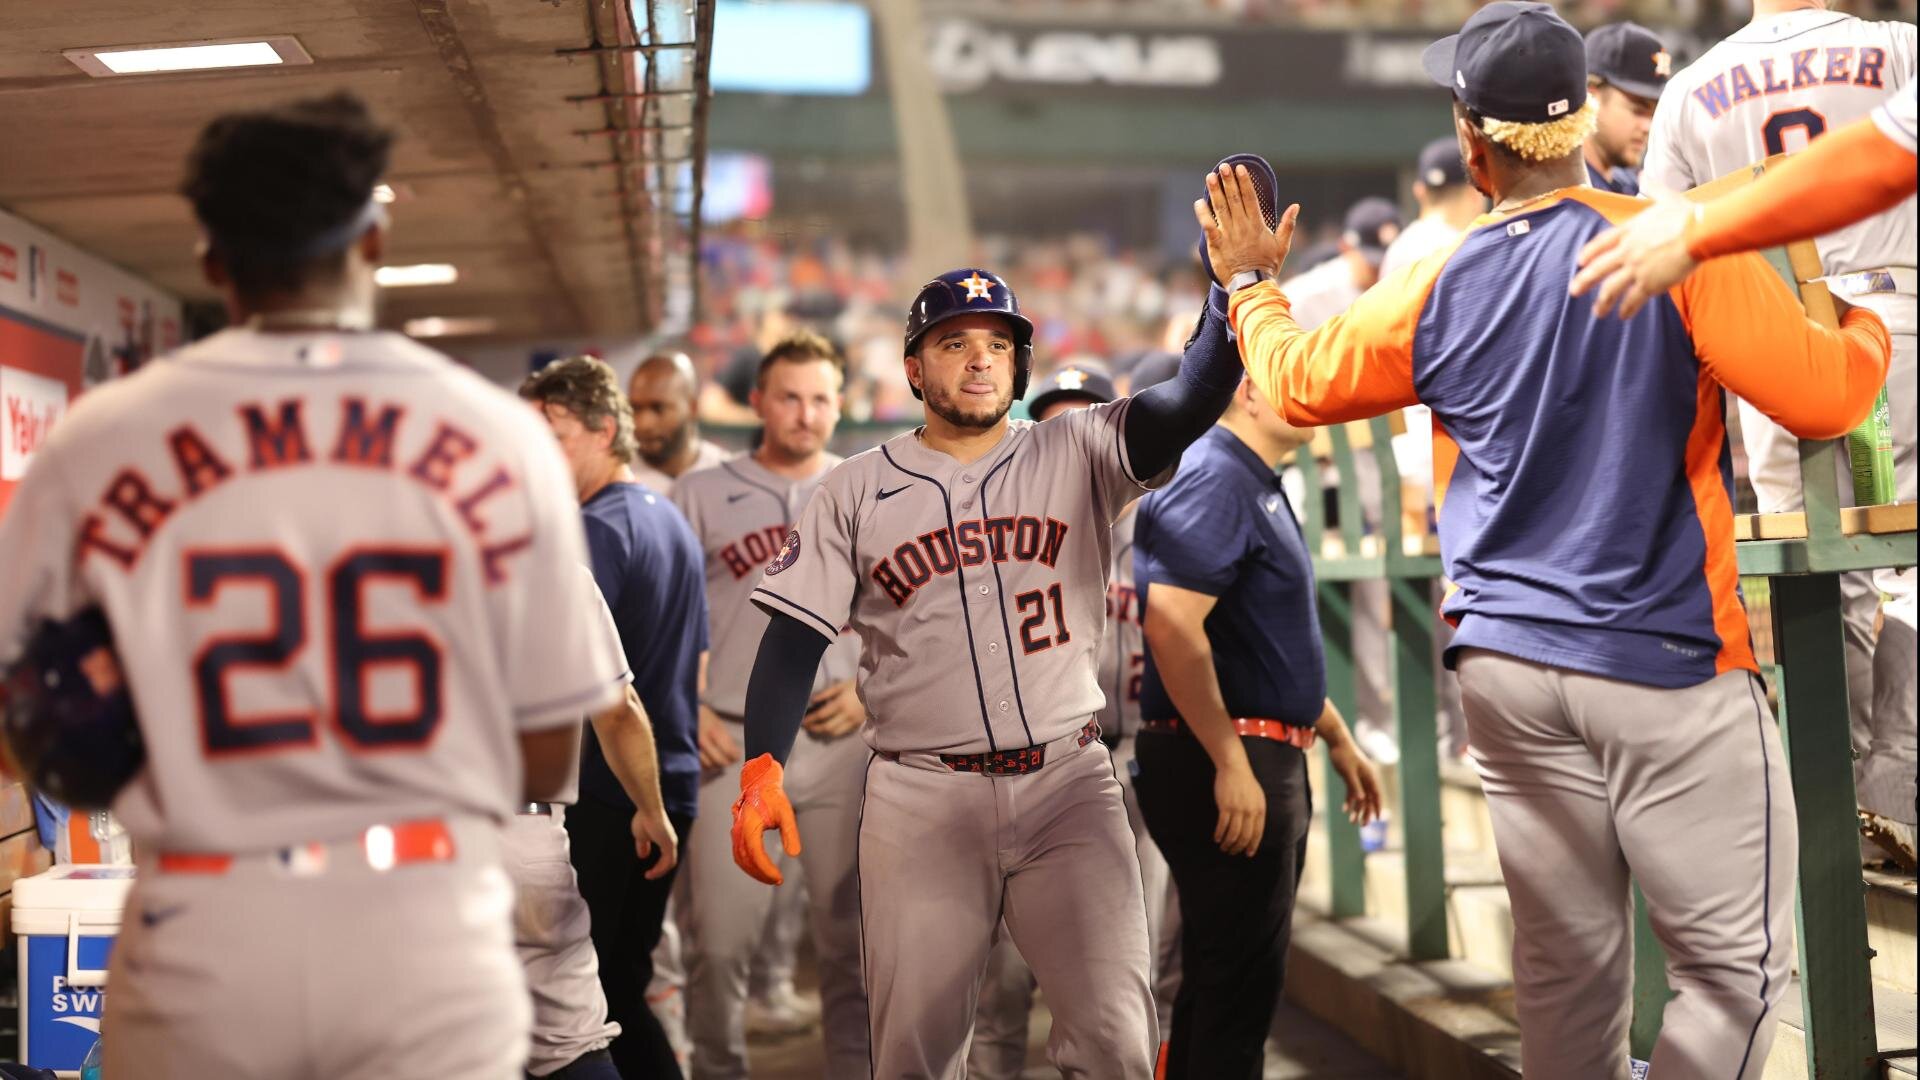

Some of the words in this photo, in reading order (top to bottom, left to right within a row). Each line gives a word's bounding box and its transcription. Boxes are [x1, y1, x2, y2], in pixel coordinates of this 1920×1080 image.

[1693, 47, 1886, 119] WALKER
[962, 276, 993, 300] H
[78, 395, 537, 588] TRAMMELL
[870, 515, 1069, 608] HOUSTON
[181, 543, 453, 758] 26
[1015, 582, 1070, 656] 21
